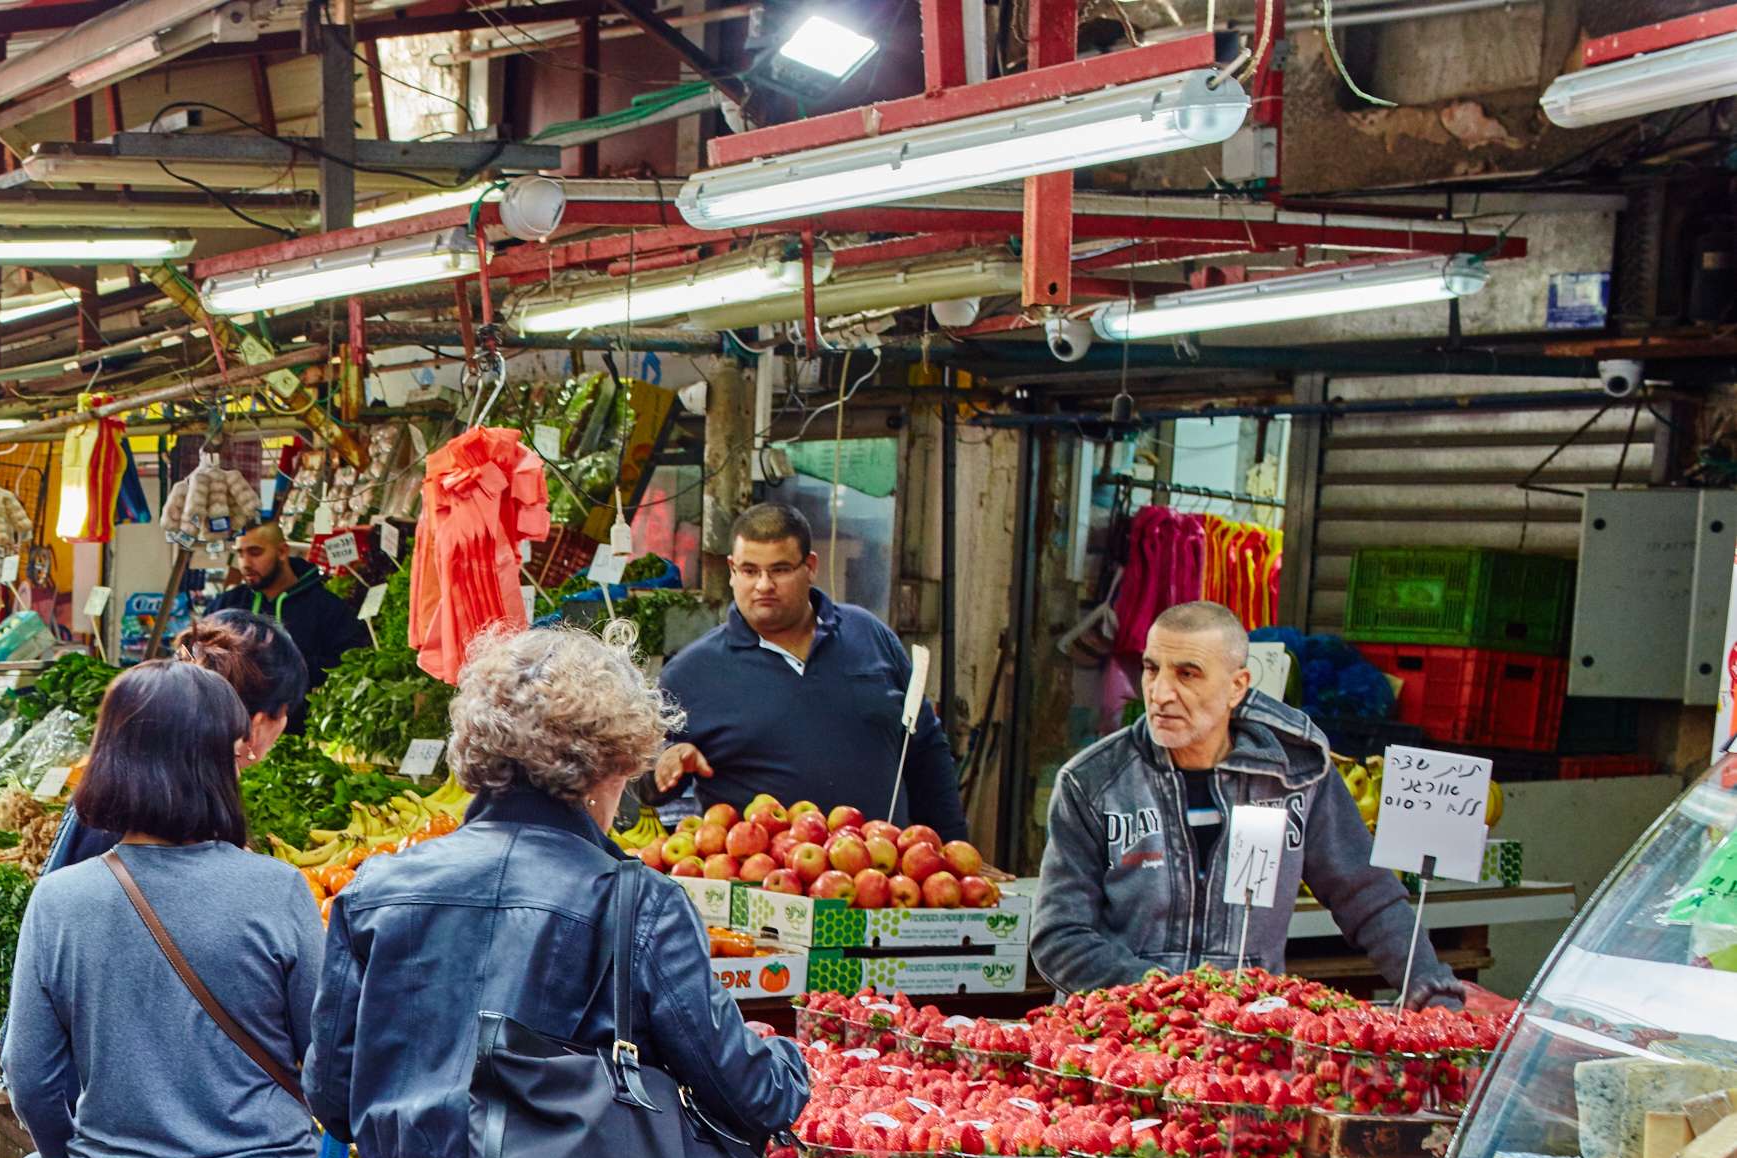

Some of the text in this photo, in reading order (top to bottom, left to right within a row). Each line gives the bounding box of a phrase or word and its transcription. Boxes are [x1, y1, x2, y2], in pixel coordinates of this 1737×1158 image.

[1433, 764, 1482, 779] תות
[1446, 798, 1482, 816] ללא
[713, 969, 751, 989] אפ
